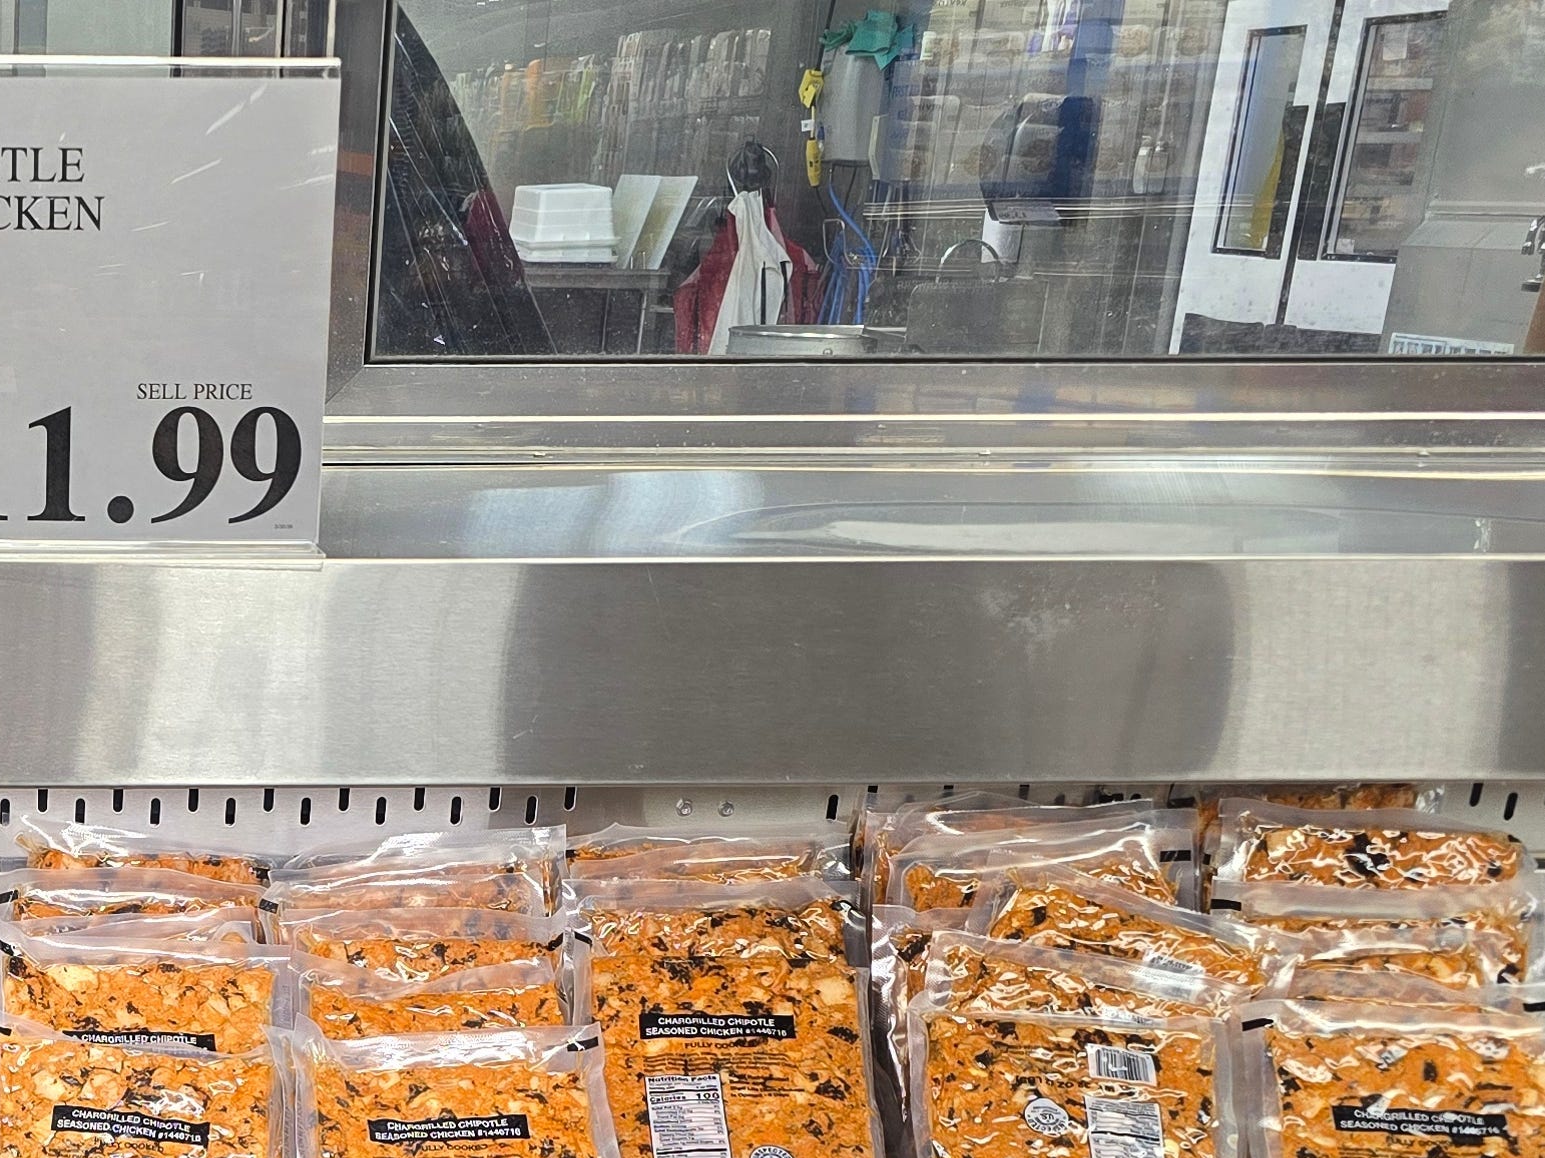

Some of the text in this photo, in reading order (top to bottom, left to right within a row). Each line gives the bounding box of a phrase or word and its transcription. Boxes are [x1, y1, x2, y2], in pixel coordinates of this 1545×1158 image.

[137, 383, 252, 401] SELL PRICE
[727, 1018, 775, 1027] CHIPOTLE
[646, 1027, 698, 1036] SEASONED
[700, 1026, 743, 1036] CHICKEN
[56, 1119, 111, 1132] SEASONED
[111, 1124, 157, 1139] CHICKEN
